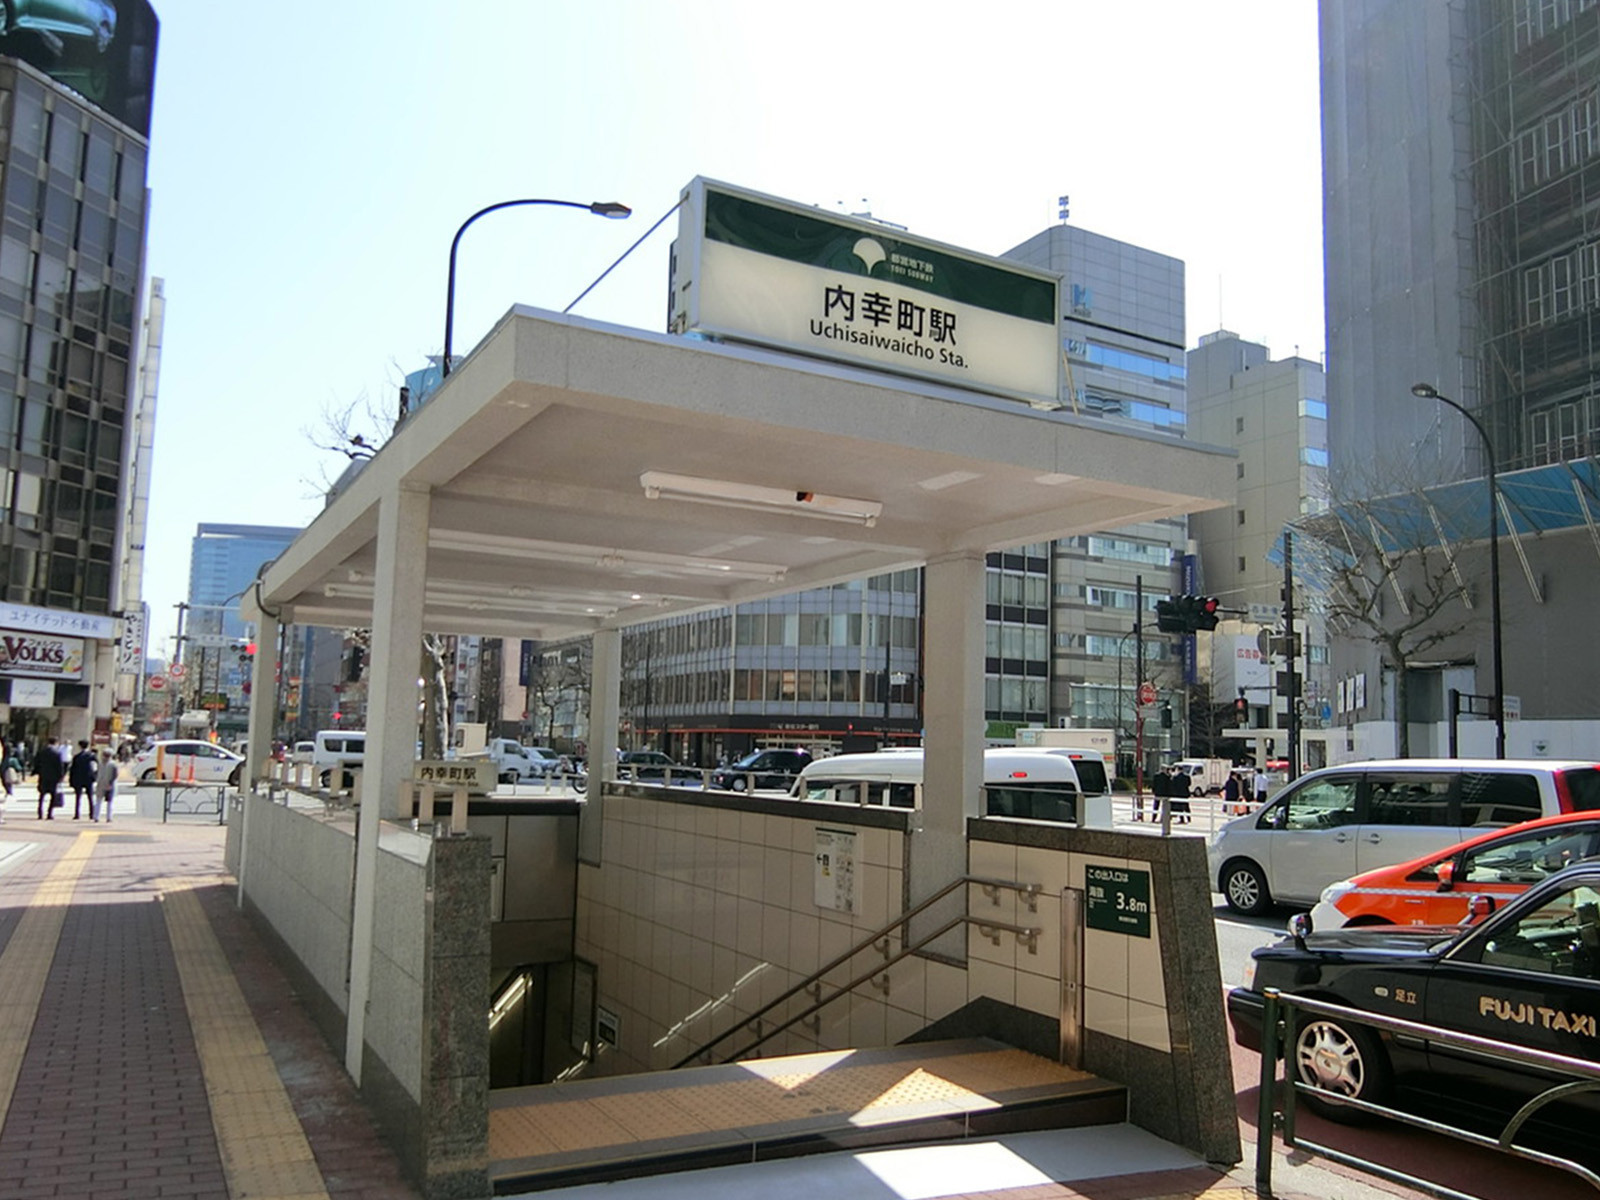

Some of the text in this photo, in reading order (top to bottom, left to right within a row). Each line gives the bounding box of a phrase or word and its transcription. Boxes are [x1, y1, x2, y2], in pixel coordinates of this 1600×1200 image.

[824, 284, 957, 346] 内幸町駅
[810, 318, 969, 369] Uchisaiwaicho Sta.
[9, 610, 99, 631] ユナイテッド不動産
[2, 636, 65, 665] VOLKS
[123, 614, 137, 664] やきとり
[421, 766, 476, 780] 内幸町駅
[1116, 891, 1148, 913] 3.8m
[1395, 988, 1417, 1005] 足立
[1479, 995, 1597, 1038] FUJI TAXI
